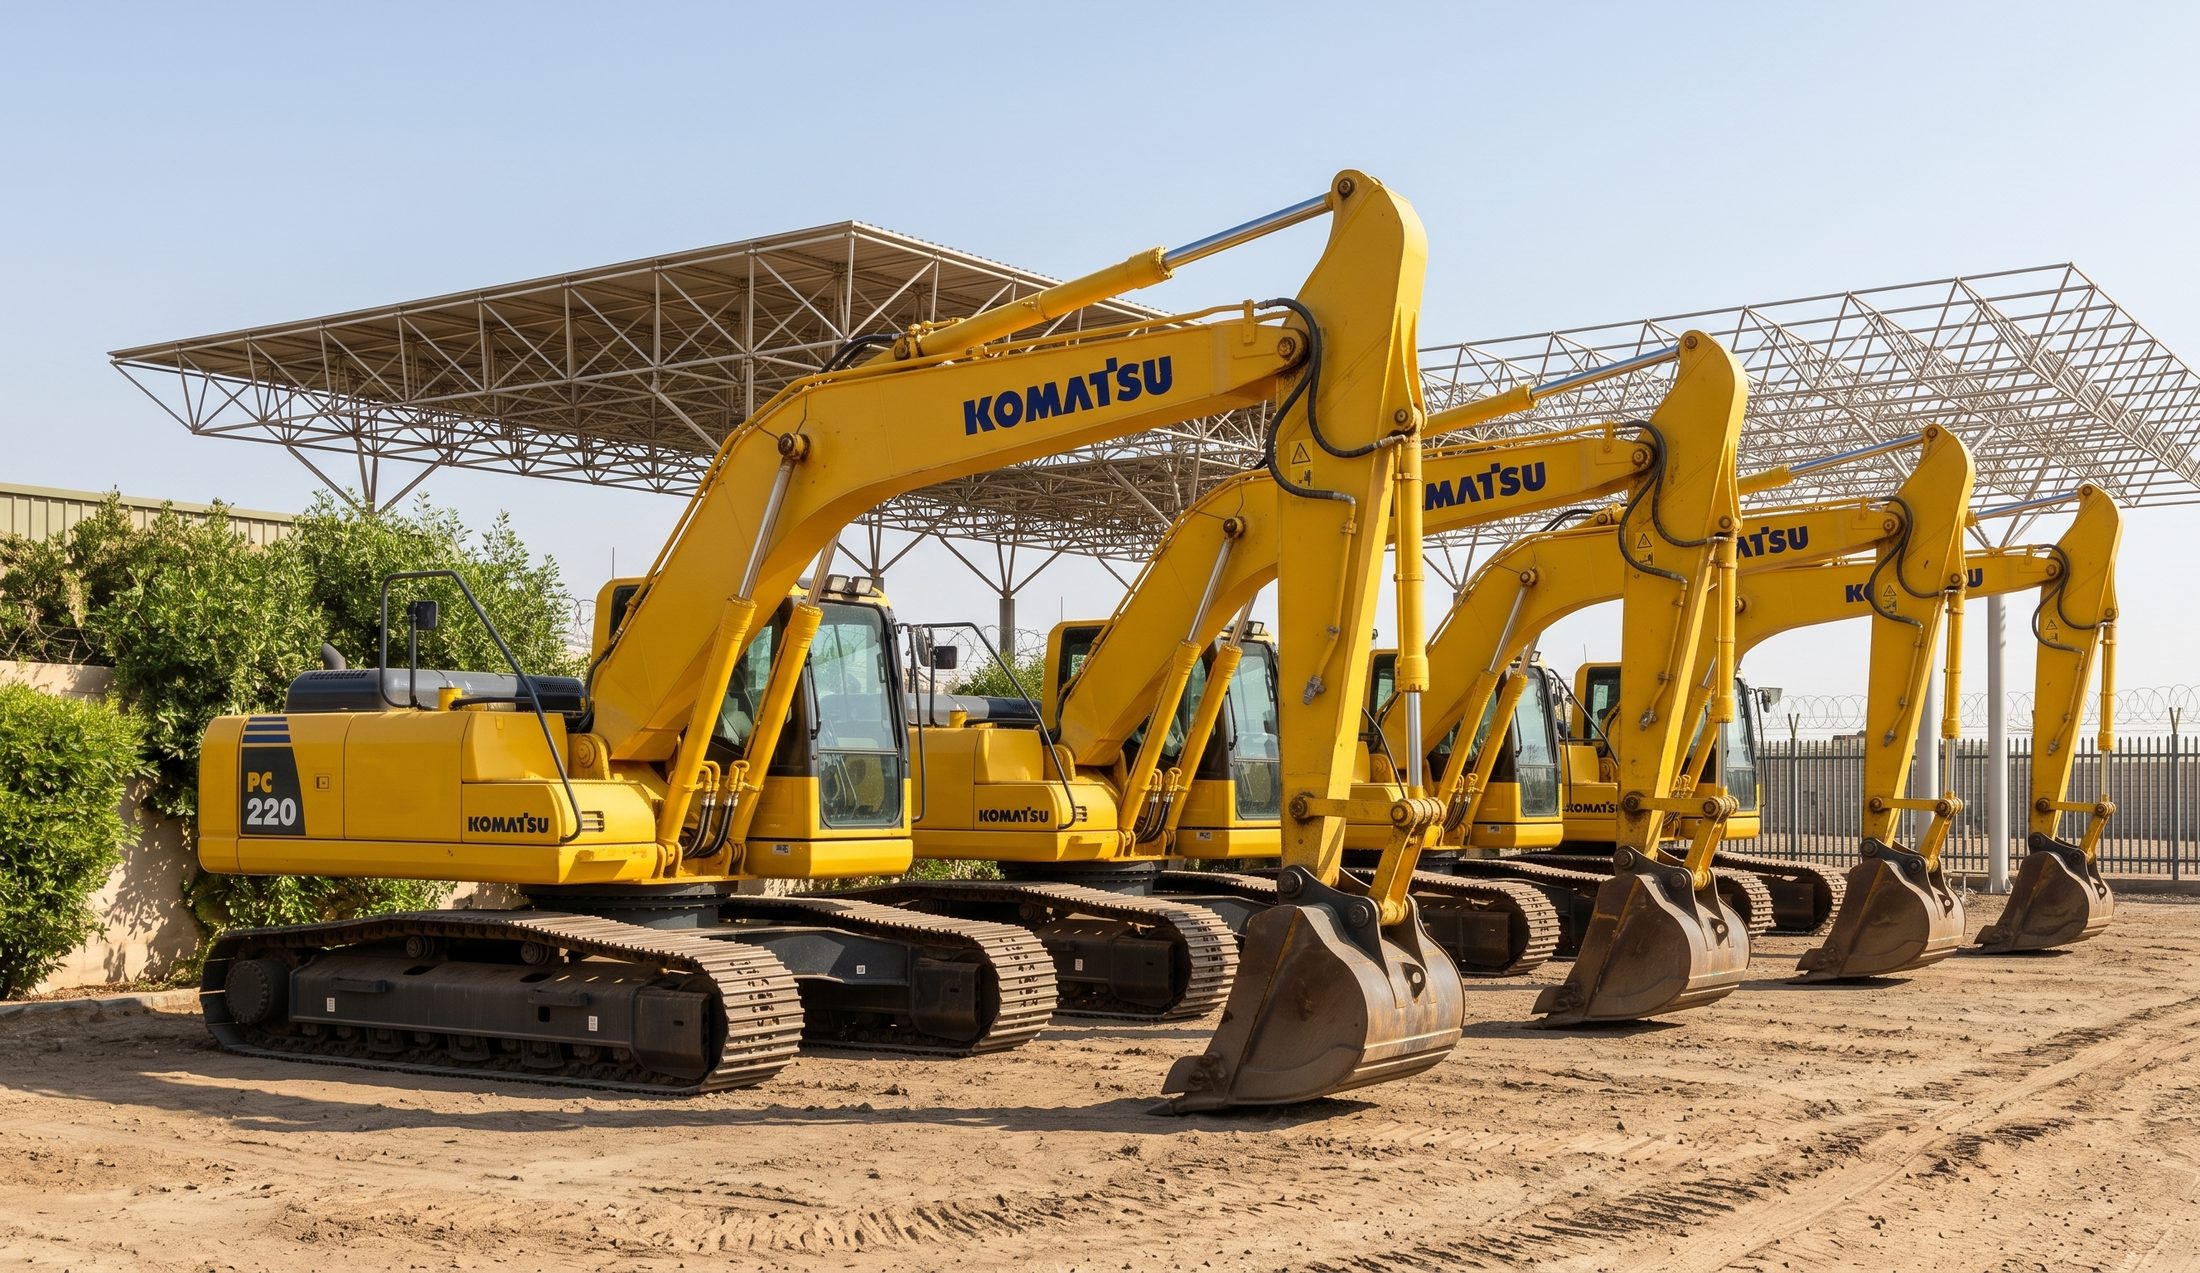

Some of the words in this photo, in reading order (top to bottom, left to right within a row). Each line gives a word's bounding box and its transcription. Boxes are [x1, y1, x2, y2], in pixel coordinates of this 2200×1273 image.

[963, 355, 1173, 436] KOMATSU
[1422, 461, 1547, 511] MATSU
[1736, 525, 1809, 560] ATSU
[247, 771, 273, 793] PC
[246, 797, 297, 827] 220
[978, 806, 1049, 823] KOMATSU
[1566, 801, 1618, 813] KOMATS
[467, 812, 549, 833] KOMATSU
